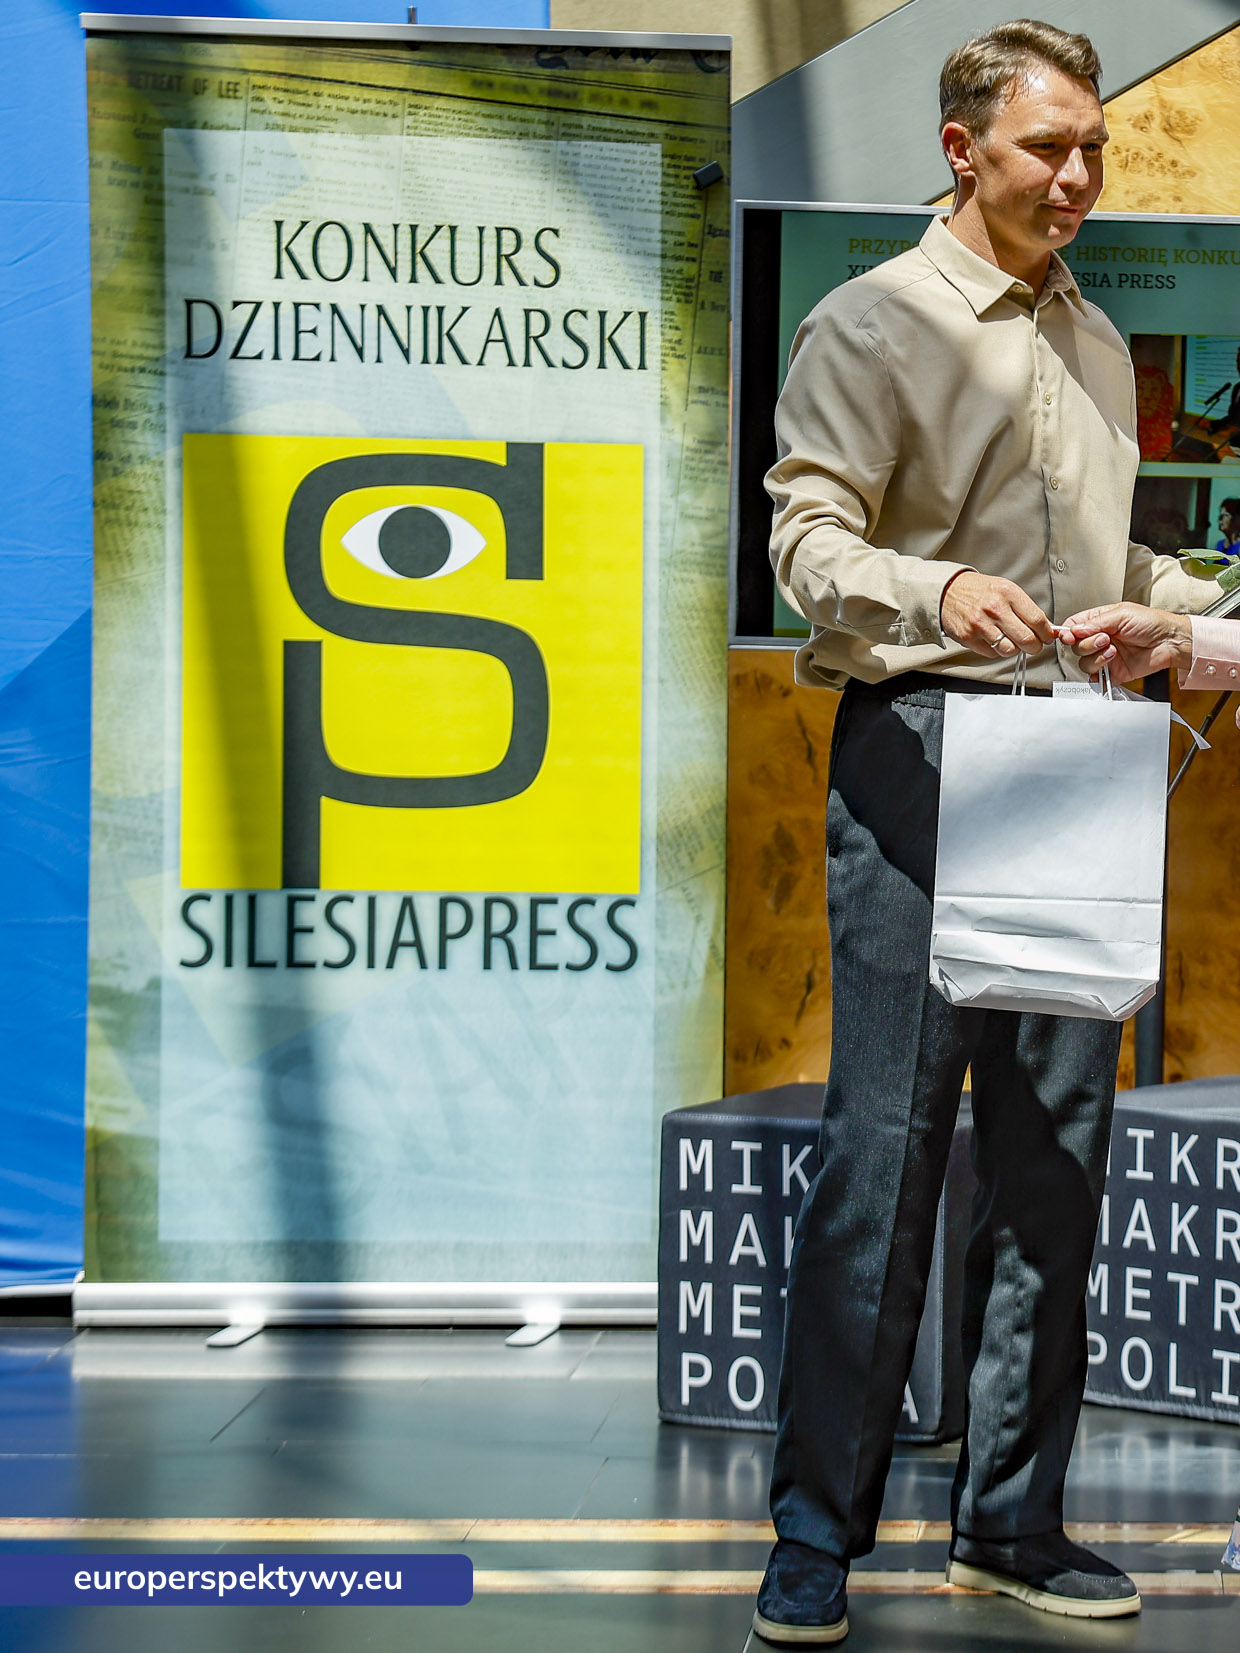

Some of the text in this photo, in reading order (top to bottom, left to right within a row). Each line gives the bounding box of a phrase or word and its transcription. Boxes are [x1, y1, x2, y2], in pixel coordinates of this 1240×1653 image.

[273, 220, 561, 288] KONKURS
[1076, 246, 1168, 267] HISTORIĘ
[1117, 273, 1177, 289] PRESS
[183, 298, 648, 370] DZIENNIKARSKI
[179, 892, 639, 972] SILESIAPRESS
[678, 1280, 788, 1339] ME
